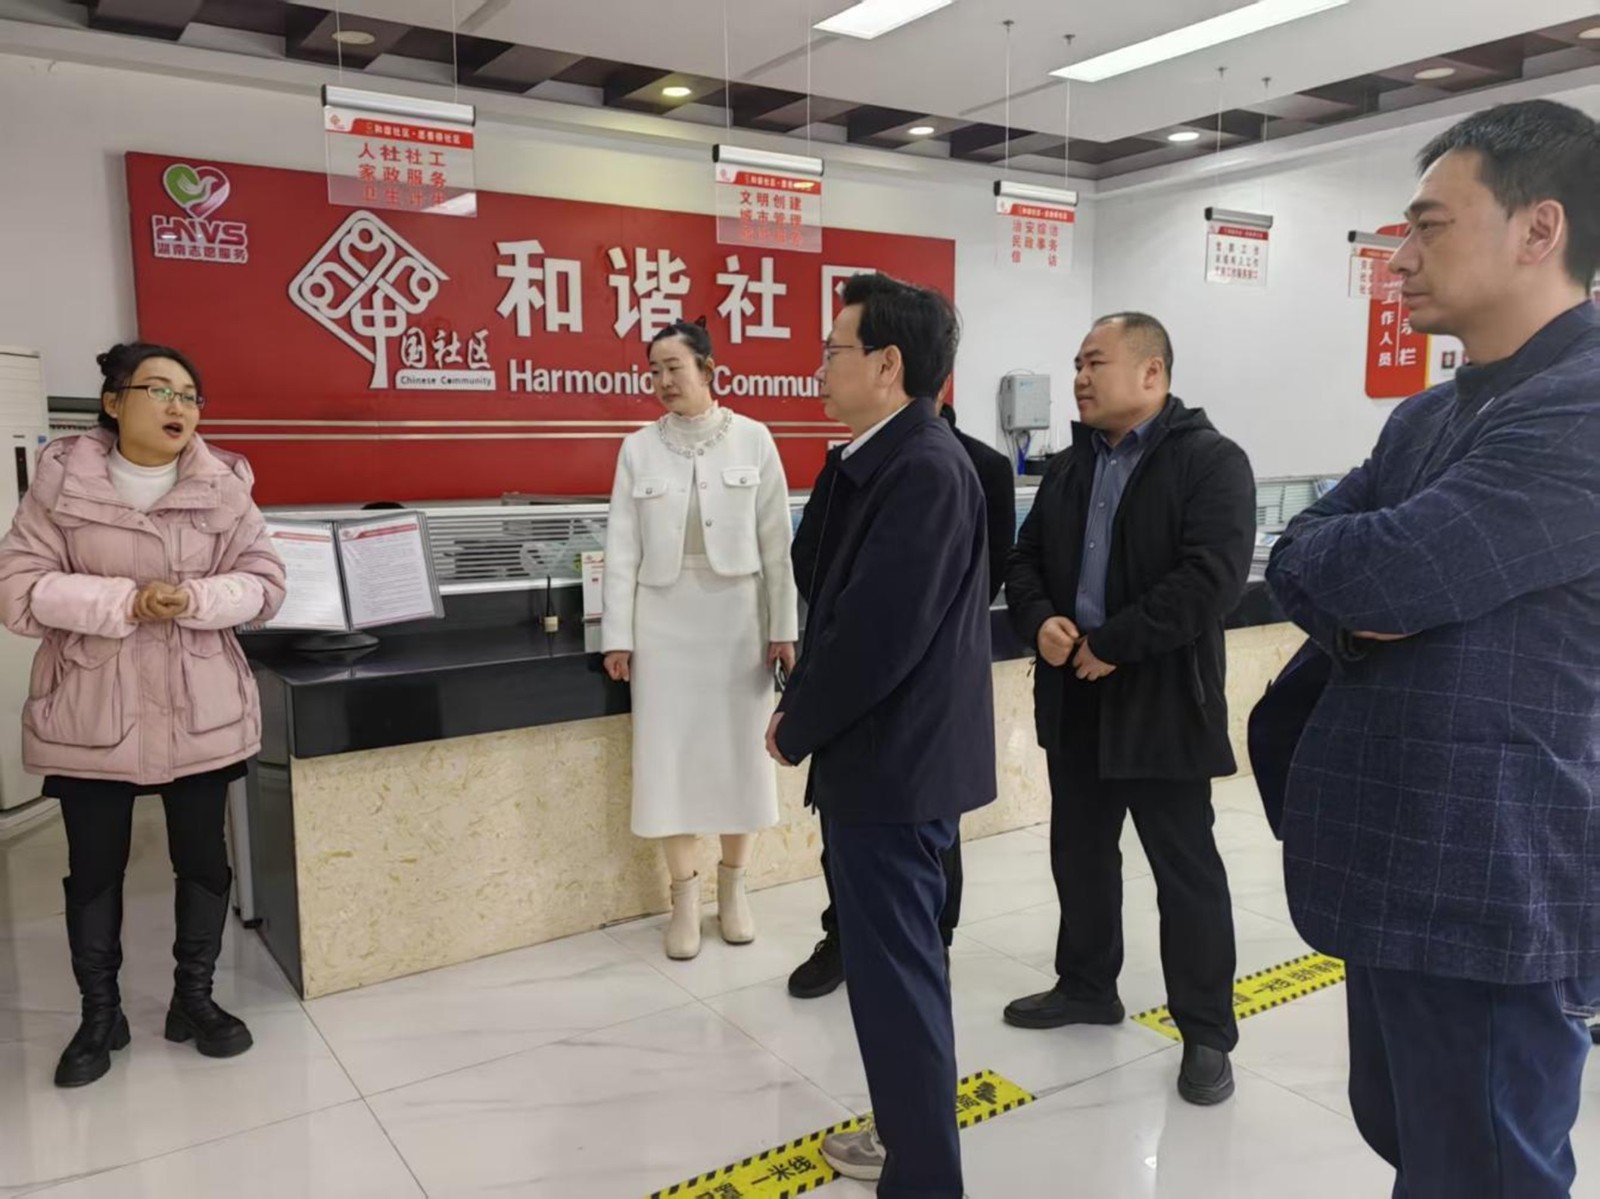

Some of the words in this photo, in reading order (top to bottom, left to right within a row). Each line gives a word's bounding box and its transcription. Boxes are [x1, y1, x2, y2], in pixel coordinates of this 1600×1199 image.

[358, 163, 446, 189] 家政服务
[740, 190, 802, 212] 文明创建
[157, 242, 245, 261] 湖南志愿服务
[400, 375, 436, 385] Chinese
[440, 375, 492, 387] Community
[751, 1155, 817, 1185] 一米线
